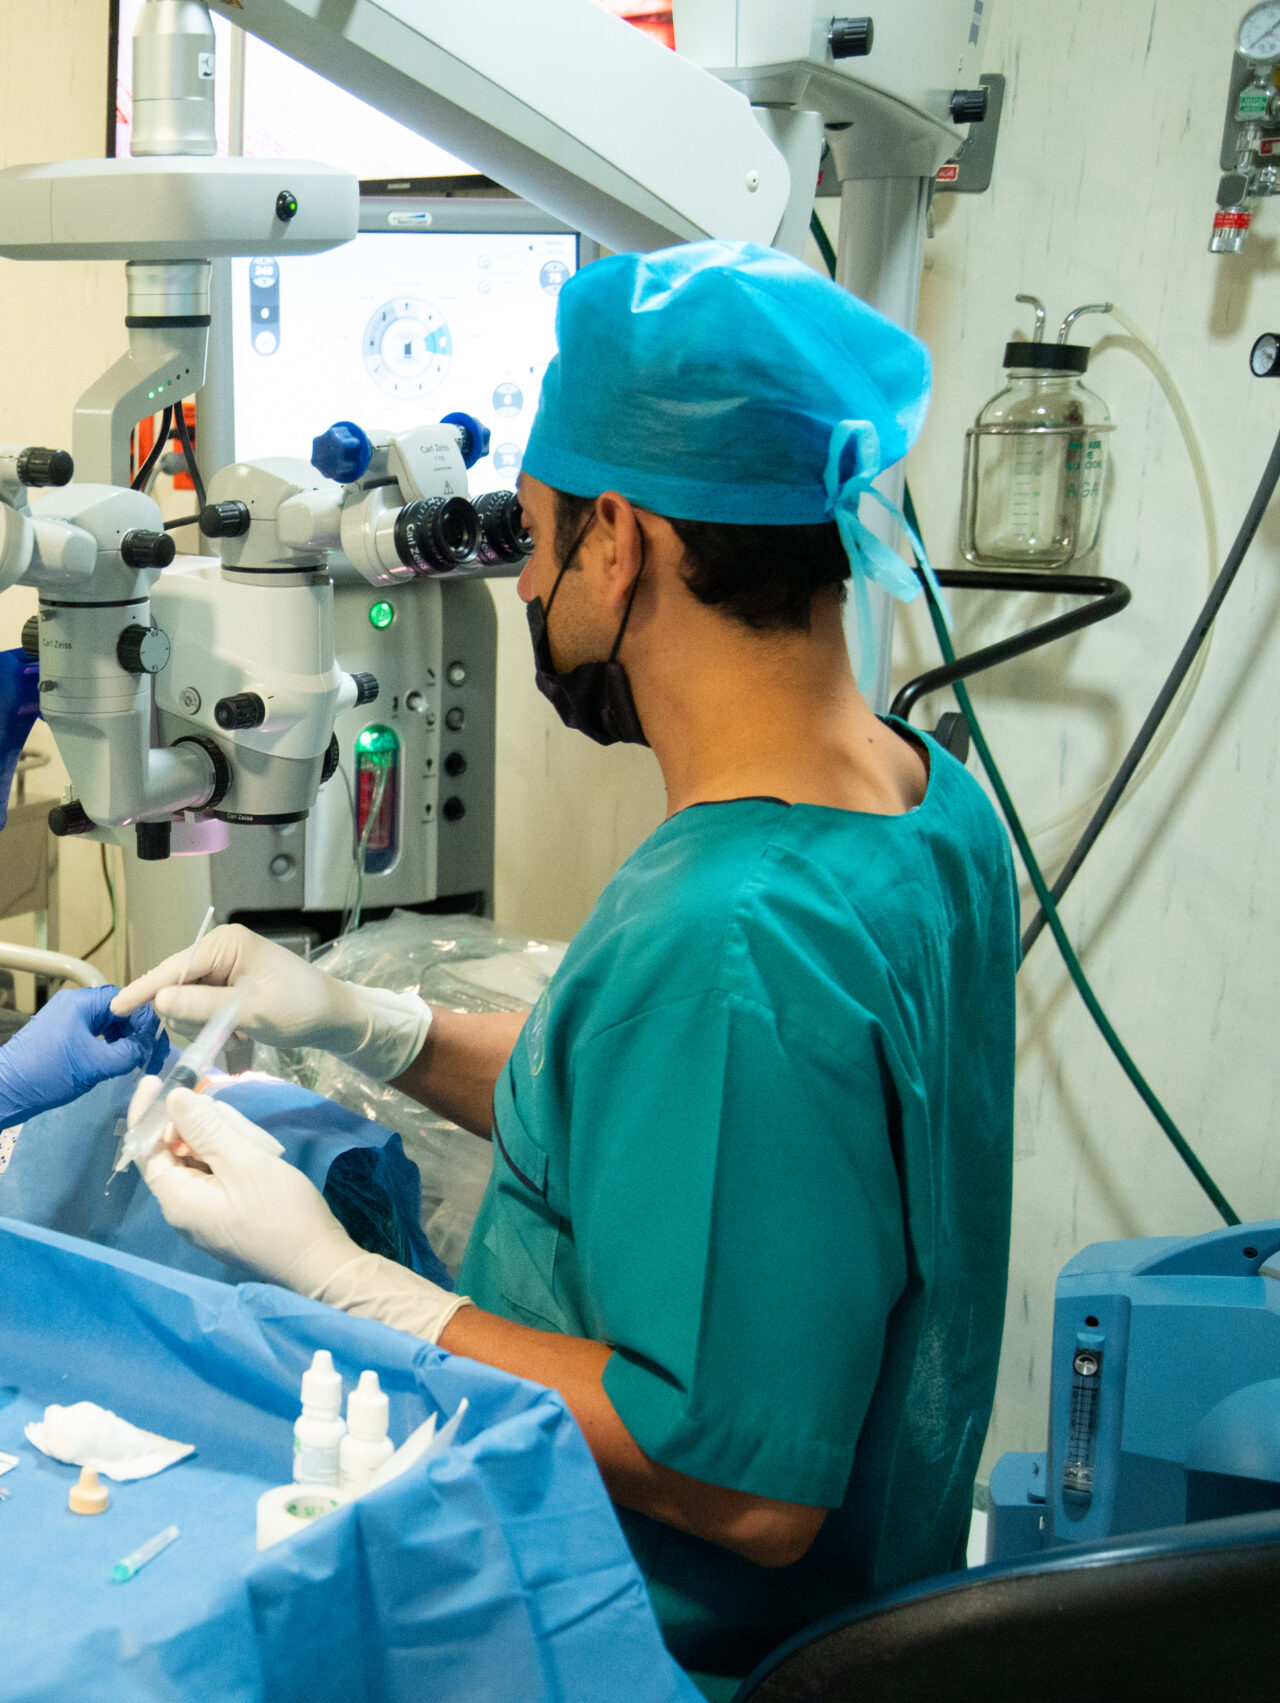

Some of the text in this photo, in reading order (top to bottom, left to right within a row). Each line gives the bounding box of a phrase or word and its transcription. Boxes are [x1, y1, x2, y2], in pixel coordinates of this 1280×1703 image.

[406, 523, 417, 545] Carl
[42, 638, 73, 650] Carl Zeiss
